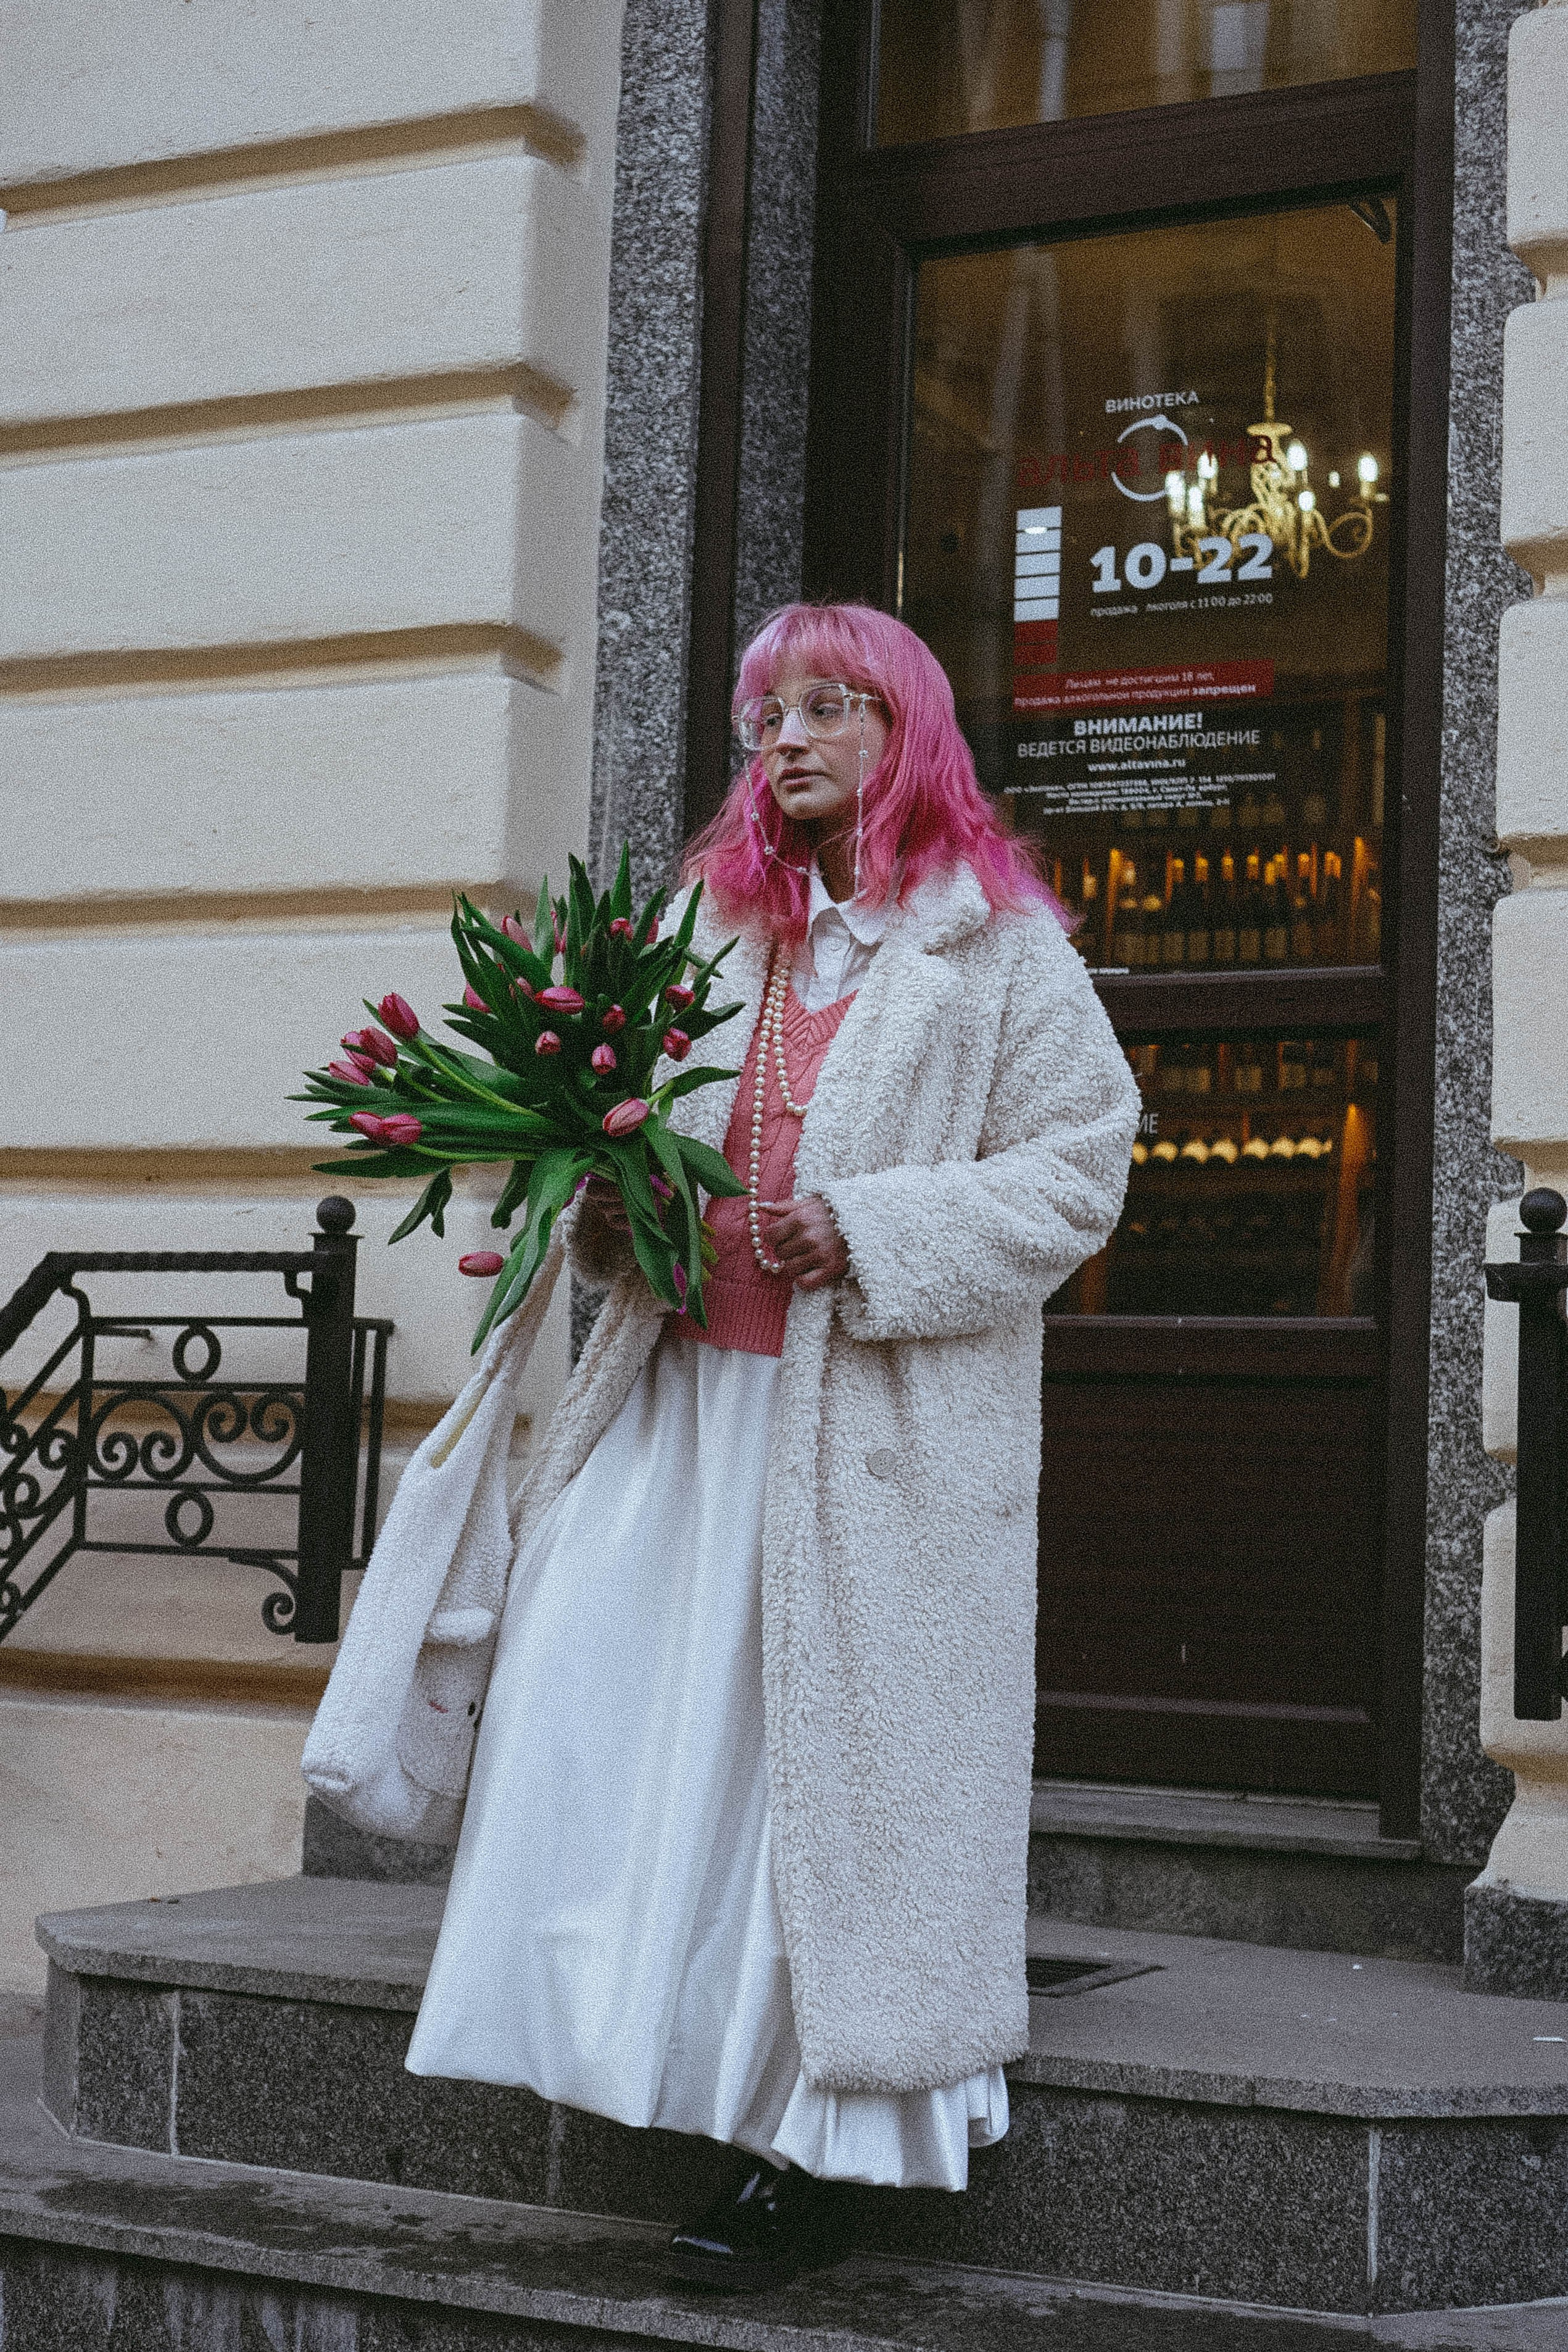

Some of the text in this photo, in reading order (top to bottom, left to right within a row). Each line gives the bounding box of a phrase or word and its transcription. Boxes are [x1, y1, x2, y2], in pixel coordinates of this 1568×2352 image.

[1105, 391, 1200, 414] ВИНОТЕКА
[1090, 533, 1273, 594] 10-22
[1181, 671, 1194, 682] 18
[1074, 712, 1203, 736] ВНИМАНИЕ!
[1018, 729, 1261, 758] ВЕДЕТСЯ ВИДЕОНАБЛЮДЕНИЕ
[1087, 758, 1187, 773] www.altavina.ru
